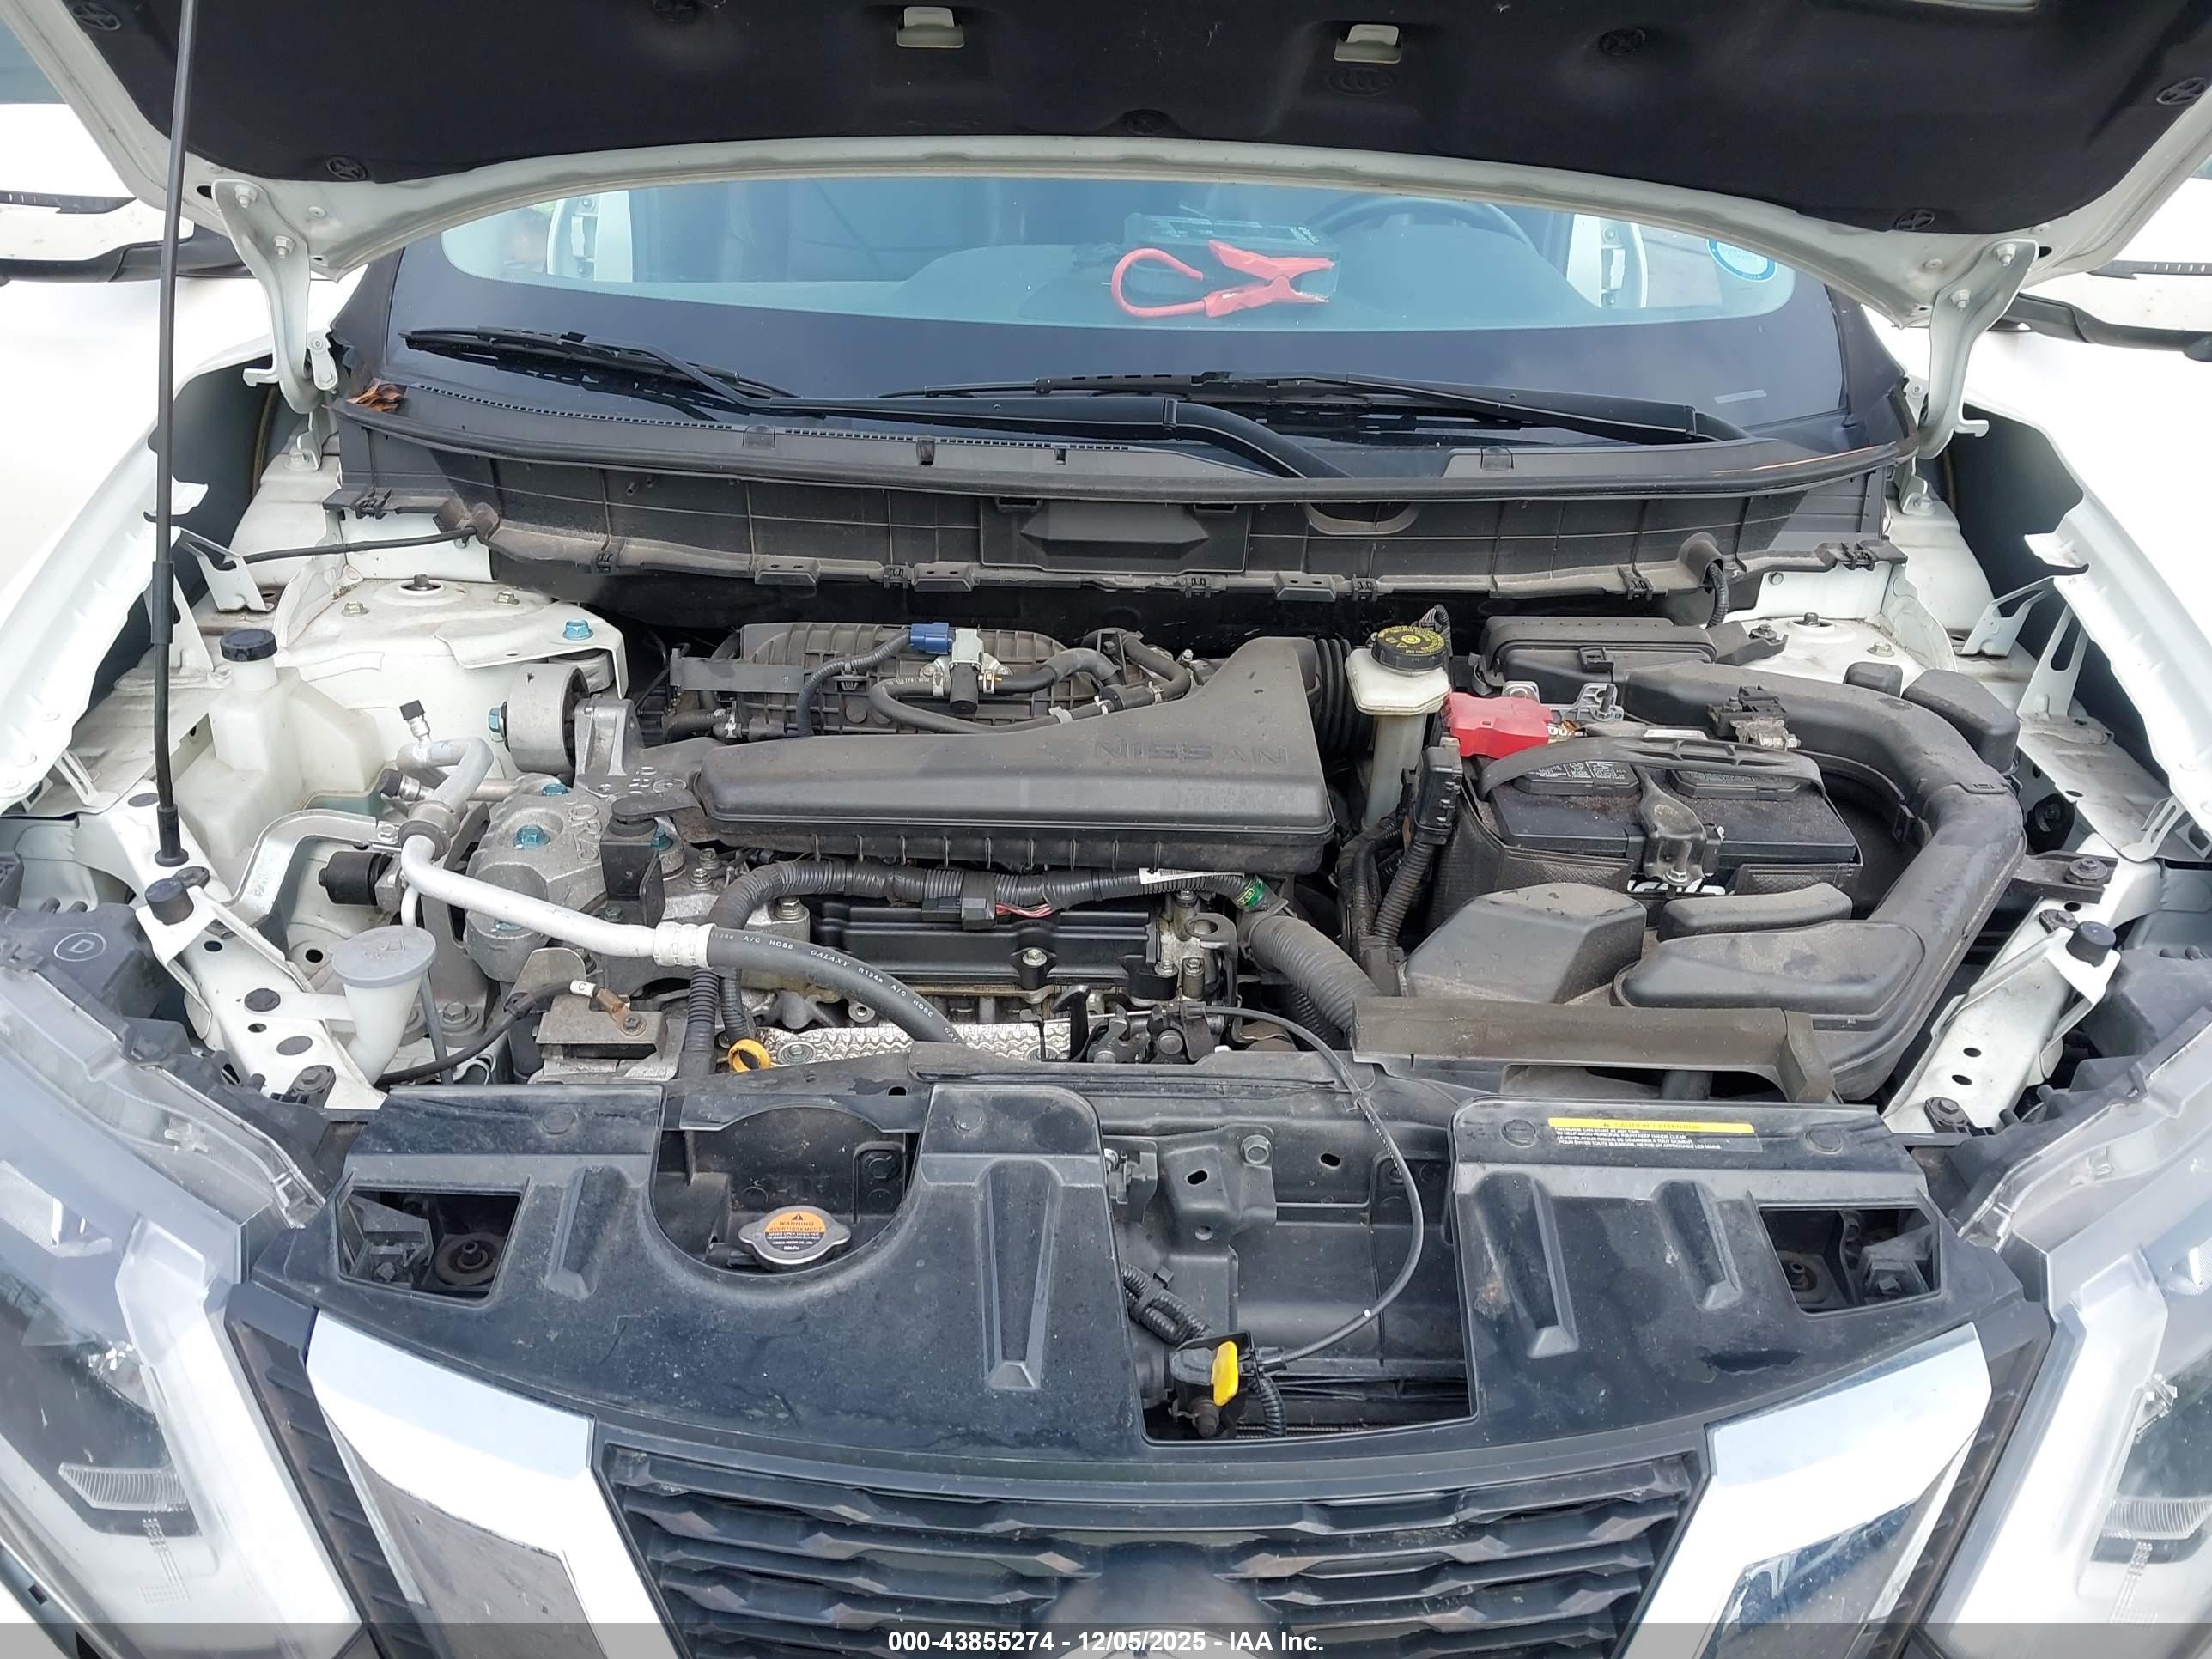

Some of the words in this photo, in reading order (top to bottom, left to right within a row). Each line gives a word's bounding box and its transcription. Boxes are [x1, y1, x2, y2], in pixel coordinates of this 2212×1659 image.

[1095, 741, 1290, 763] NISSAN
[743, 934, 762, 944] A/C
[769, 939, 794, 950] HOSE
[810, 949, 851, 968] GALAXY
[890, 984, 908, 998] A/C
